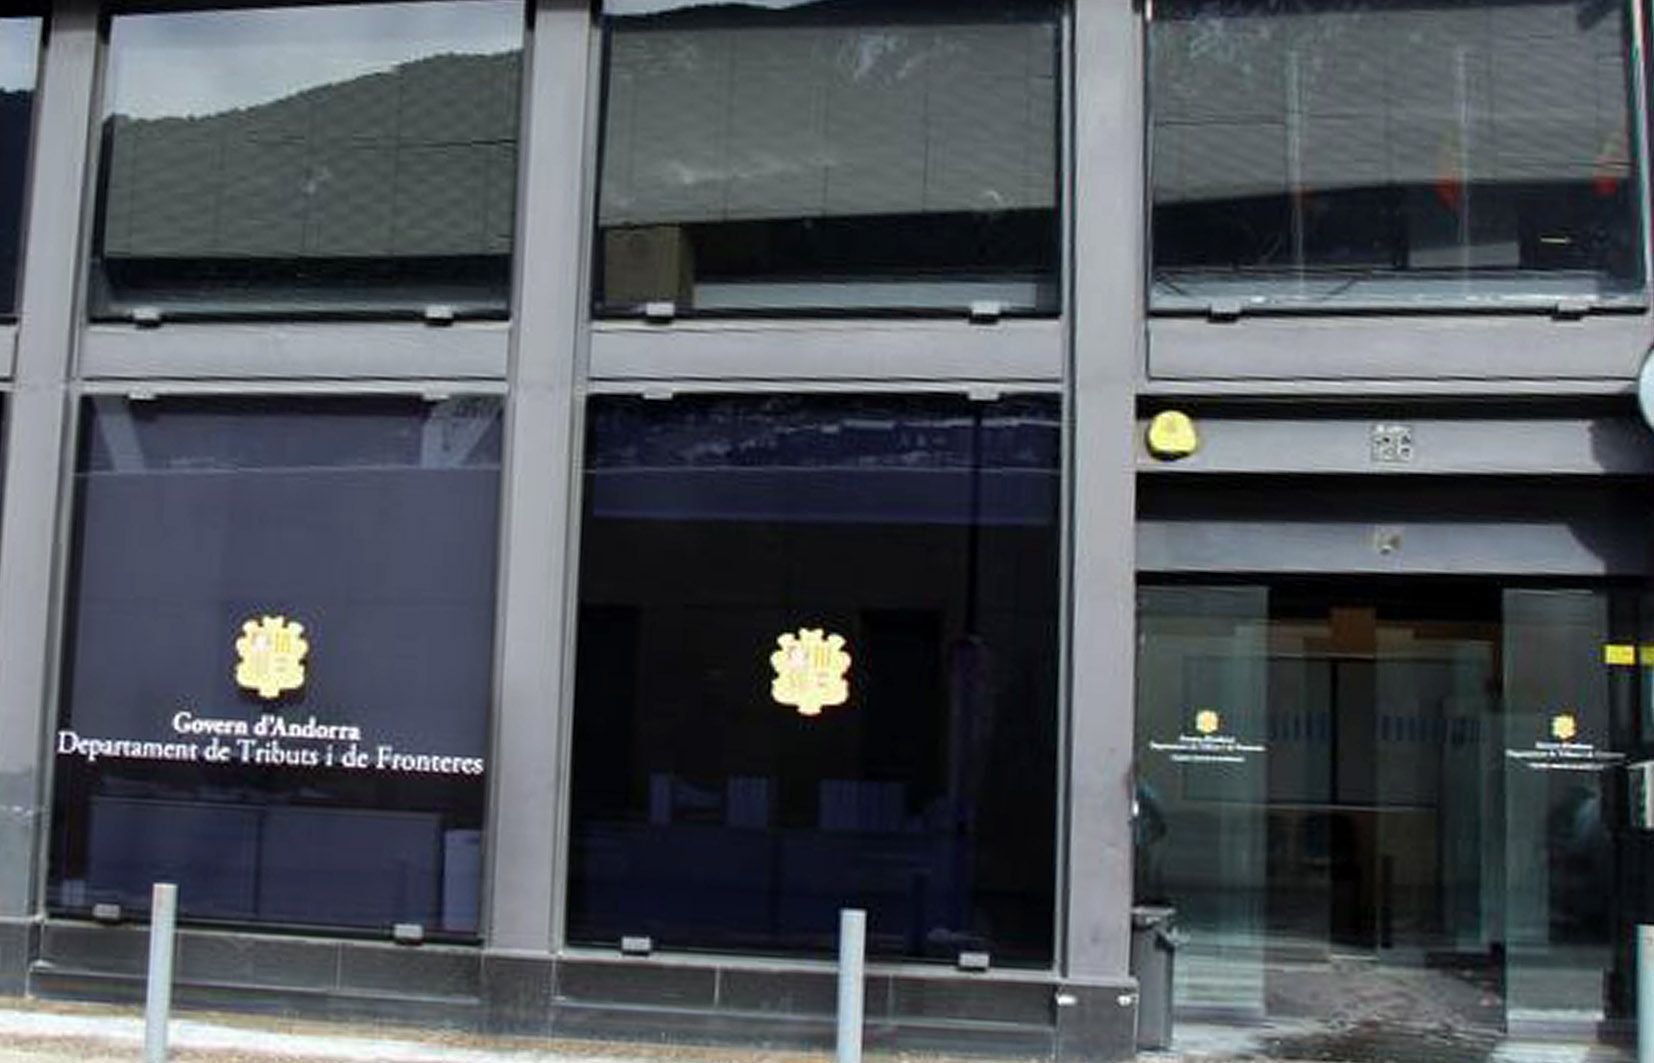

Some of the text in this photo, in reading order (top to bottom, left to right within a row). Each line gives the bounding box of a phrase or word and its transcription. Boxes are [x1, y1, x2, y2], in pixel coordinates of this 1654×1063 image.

[173, 711, 361, 740] Govern d'Andorra
[58, 730, 200, 762] Departament
[204, 737, 231, 762] de
[236, 738, 319, 766] Tributs
[342, 743, 370, 768] de
[376, 745, 484, 775] Fronteres
